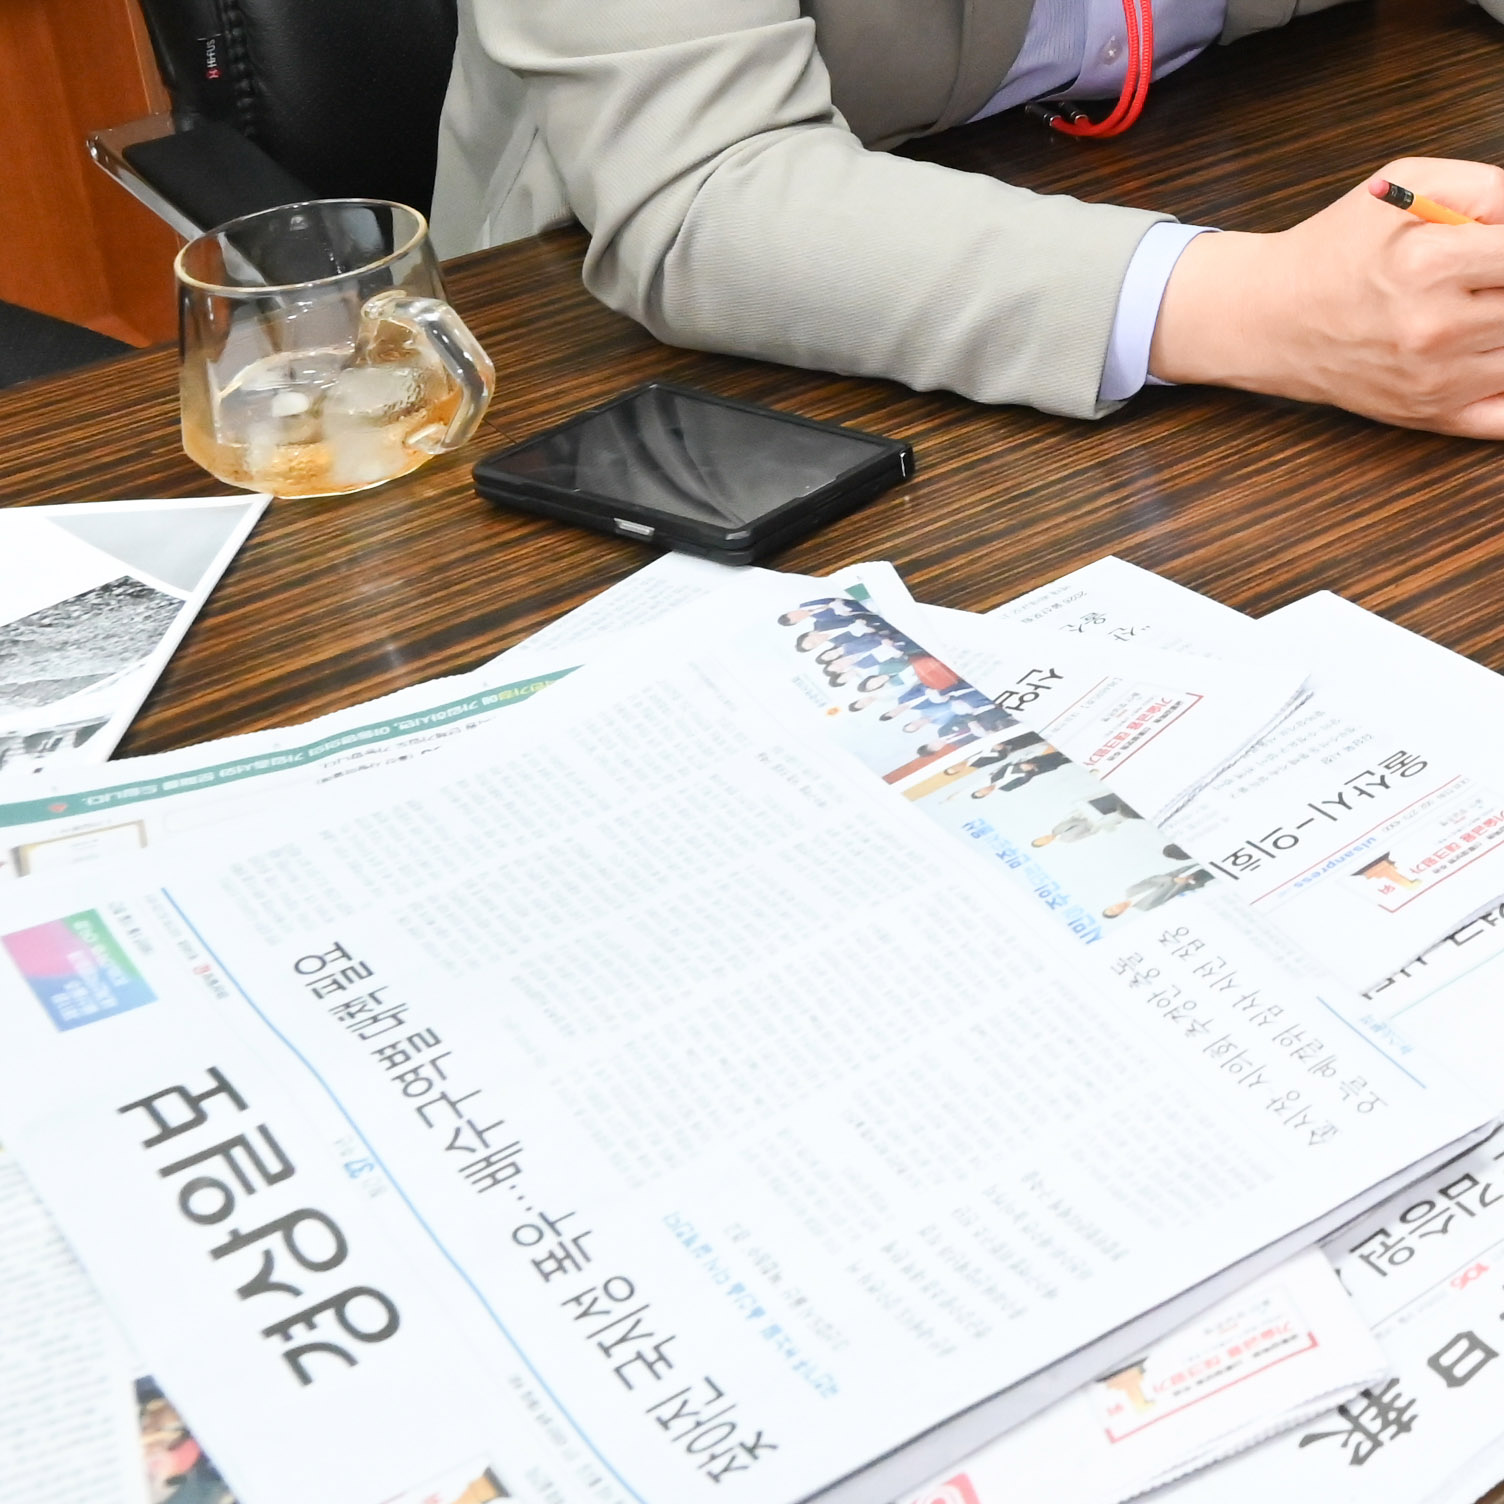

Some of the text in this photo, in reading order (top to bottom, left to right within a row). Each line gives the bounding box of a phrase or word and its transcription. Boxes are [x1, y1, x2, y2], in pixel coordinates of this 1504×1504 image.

[1210, 750, 1427, 880] 울산시-의회
[293, 941, 372, 999] 필요
[330, 986, 408, 1041] 대책
[1111, 952, 1161, 988] 충돌
[1150, 984, 1213, 1036] 추경안
[1158, 926, 1388, 1114] 오늘 예결위 심사 시선 집중
[342, 1147, 379, 1180] 37
[123, 1069, 399, 1383] 경상일보
[1348, 1172, 1502, 1276] 김승원
[562, 1275, 674, 1390] 국지성
[647, 1376, 777, 1483] 잦아진
